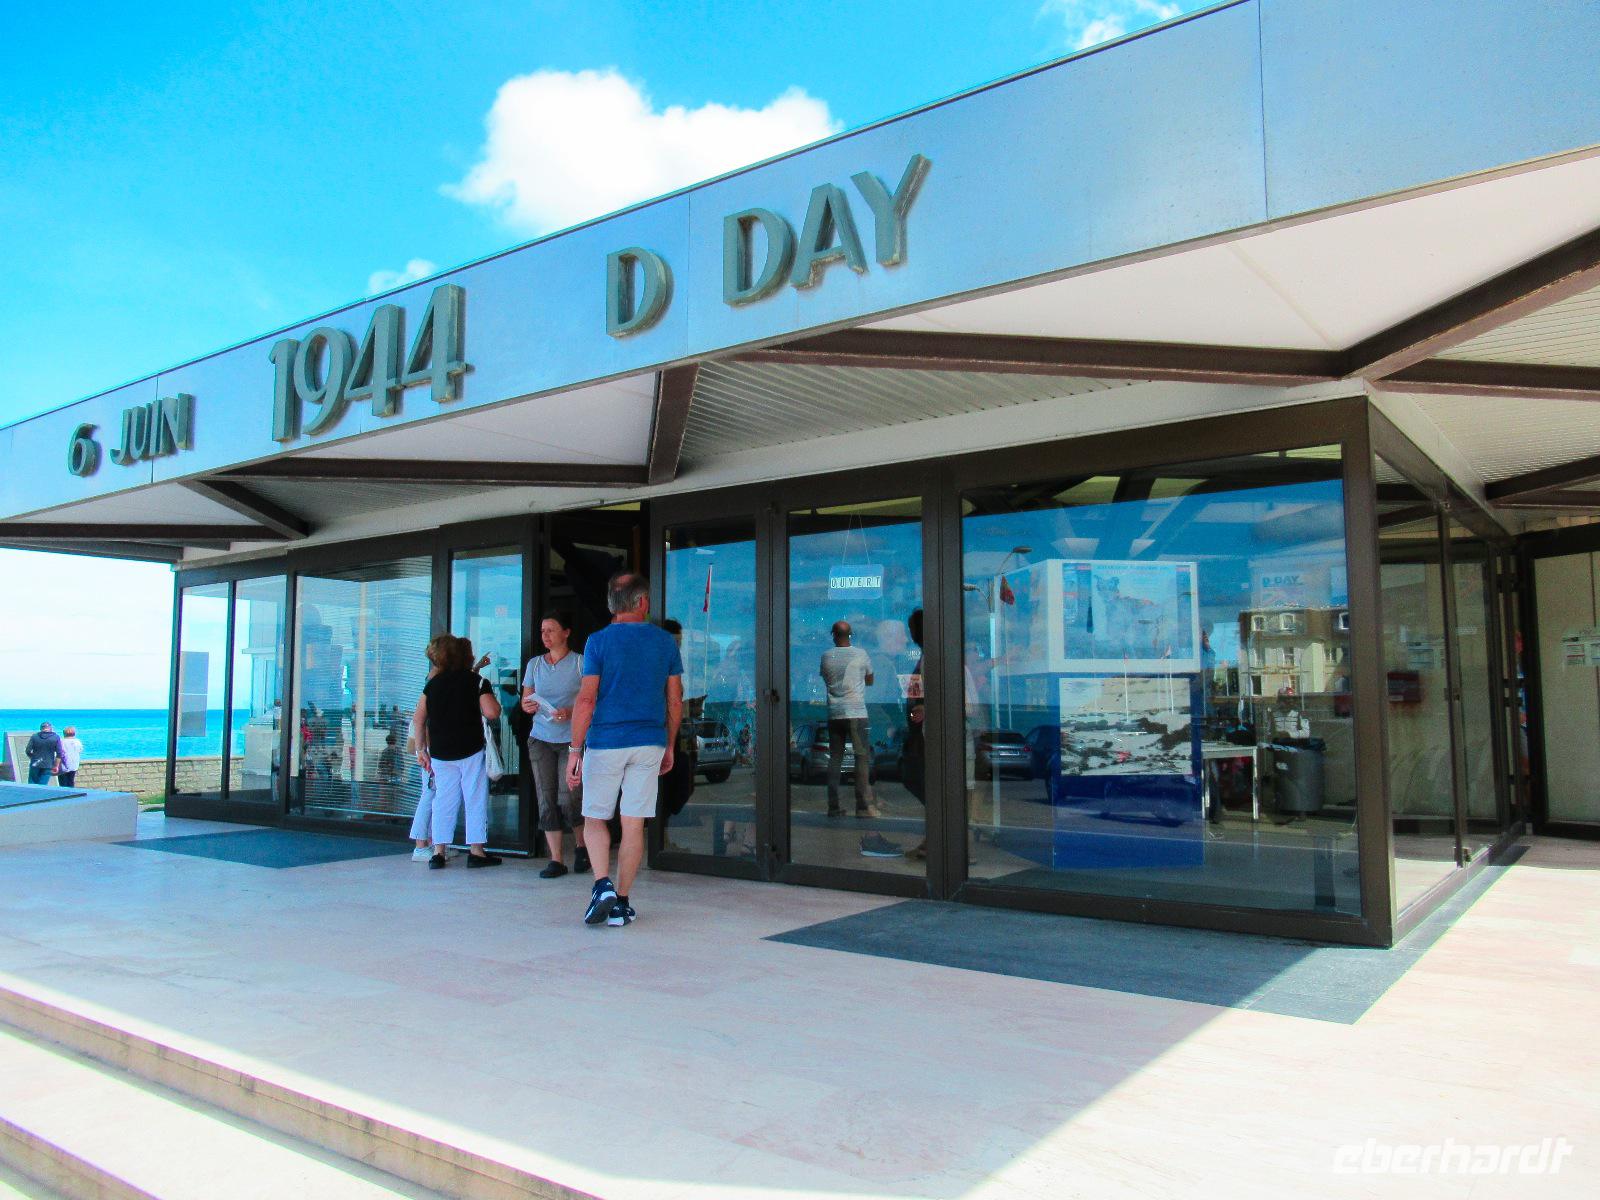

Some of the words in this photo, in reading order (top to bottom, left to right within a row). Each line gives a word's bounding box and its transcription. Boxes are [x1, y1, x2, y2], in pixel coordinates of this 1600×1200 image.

[68, 423, 99, 477] 6
[110, 393, 195, 465] JUIN
[268, 284, 470, 443] 1944
[606, 247, 673, 338] D
[723, 153, 932, 308] DAY
[831, 577, 881, 588] OUVERT
